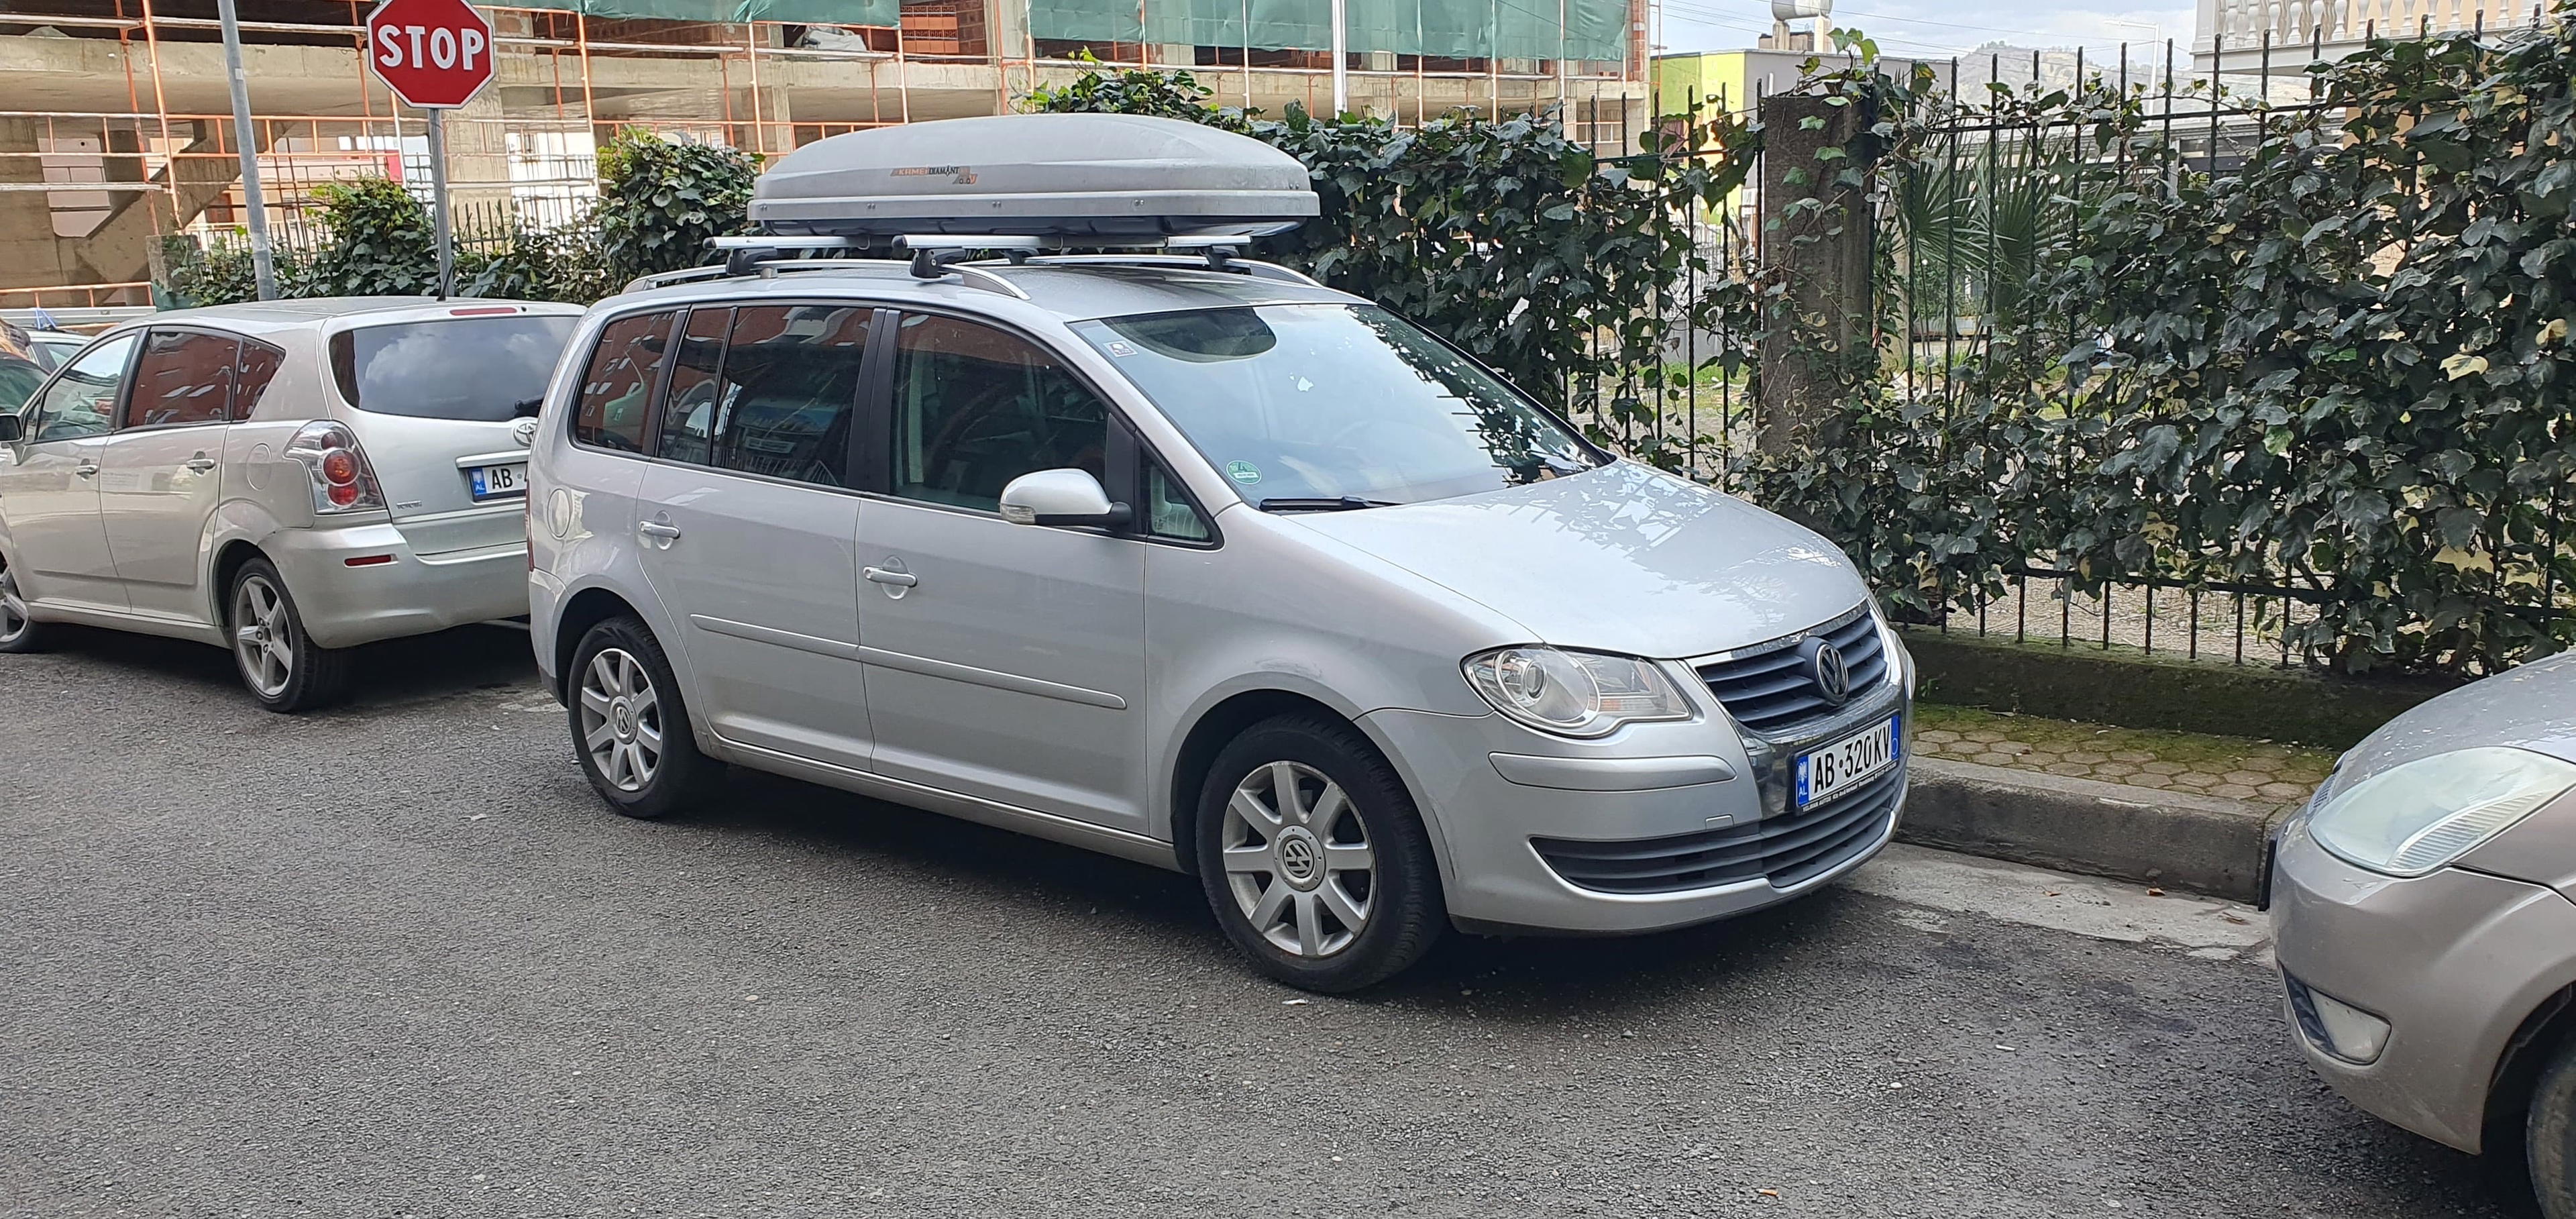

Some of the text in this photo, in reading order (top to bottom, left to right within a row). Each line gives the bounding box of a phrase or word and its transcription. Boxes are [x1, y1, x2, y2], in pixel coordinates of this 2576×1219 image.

[378, 24, 484, 70] STOP
[492, 468, 513, 490] AB
[475, 484, 485, 492] AL
[1798, 786, 1808, 798] AL
